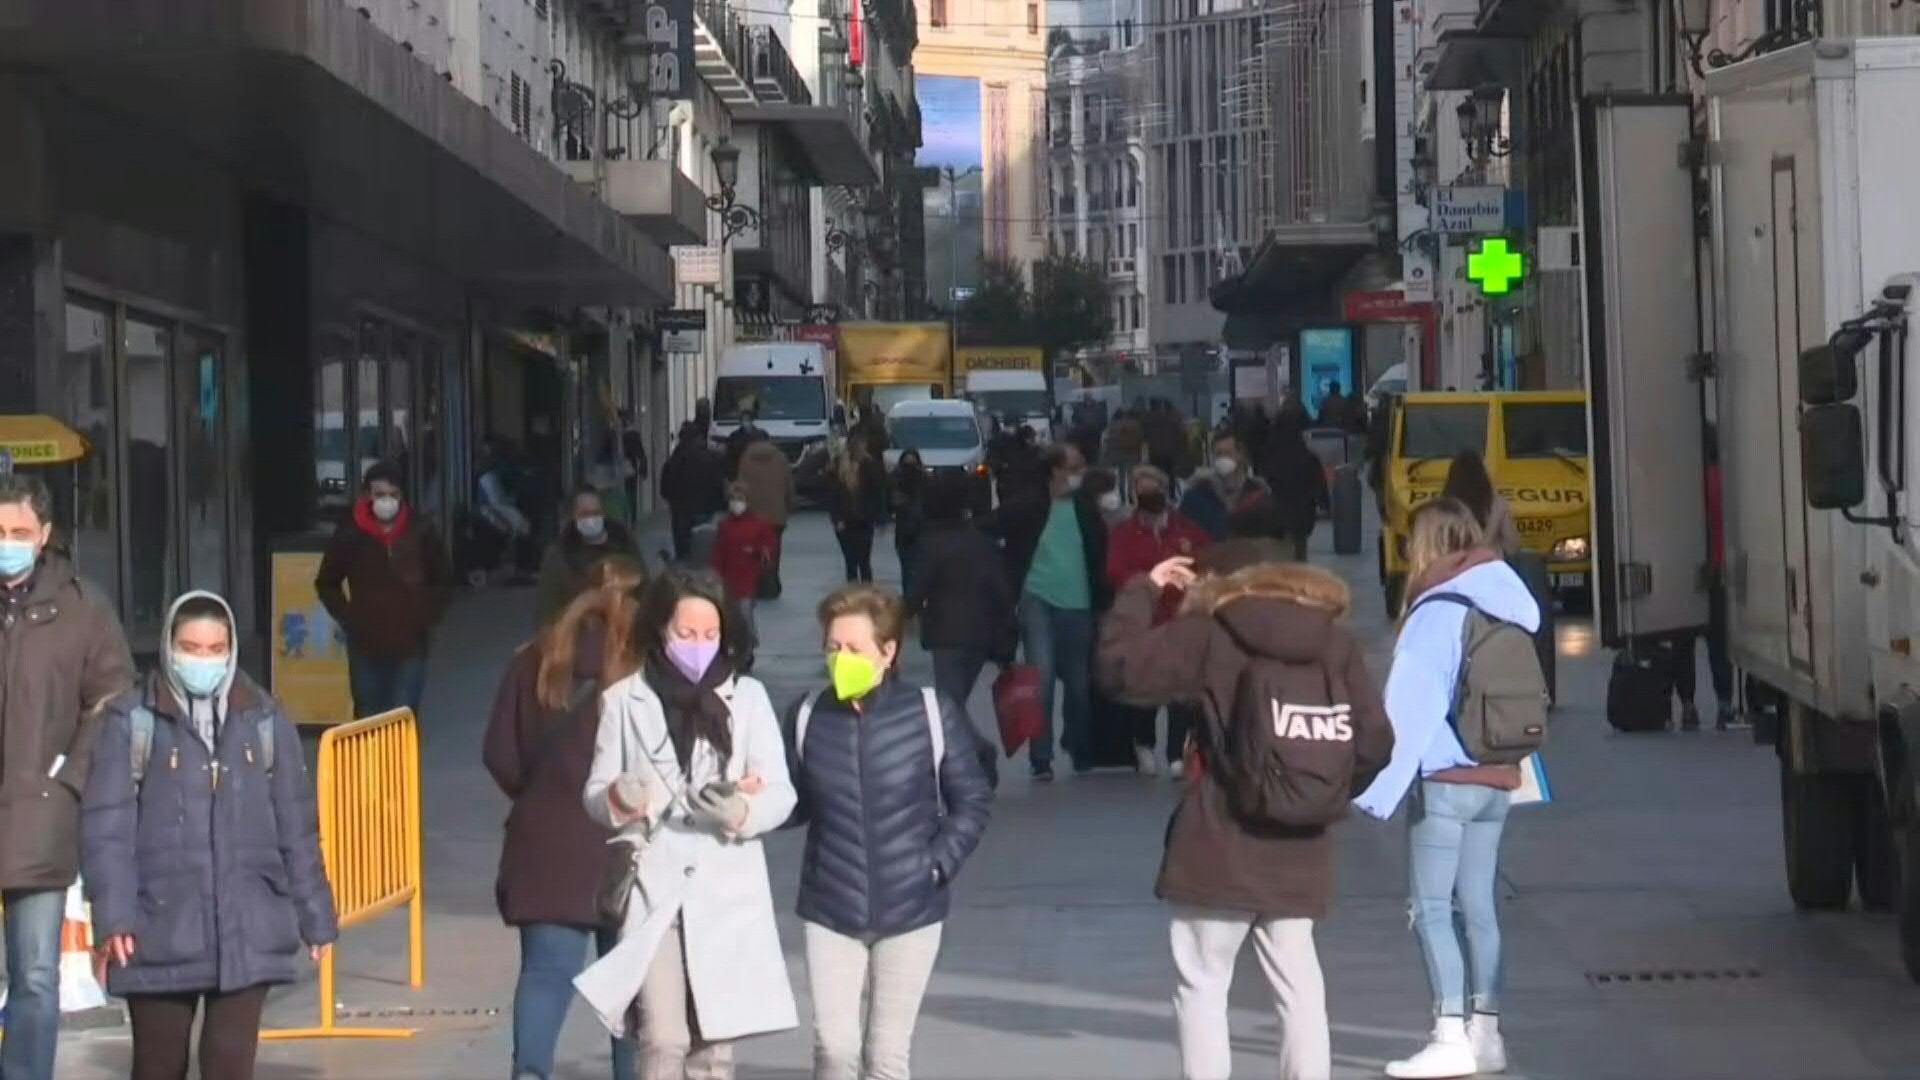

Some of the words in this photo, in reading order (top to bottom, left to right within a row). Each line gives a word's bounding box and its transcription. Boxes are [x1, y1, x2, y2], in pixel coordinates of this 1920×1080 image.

[1436, 188, 1453, 202] El
[1437, 202, 1500, 217] Danubio
[1438, 216, 1473, 231] Azul
[1270, 697, 1353, 742] VANS
